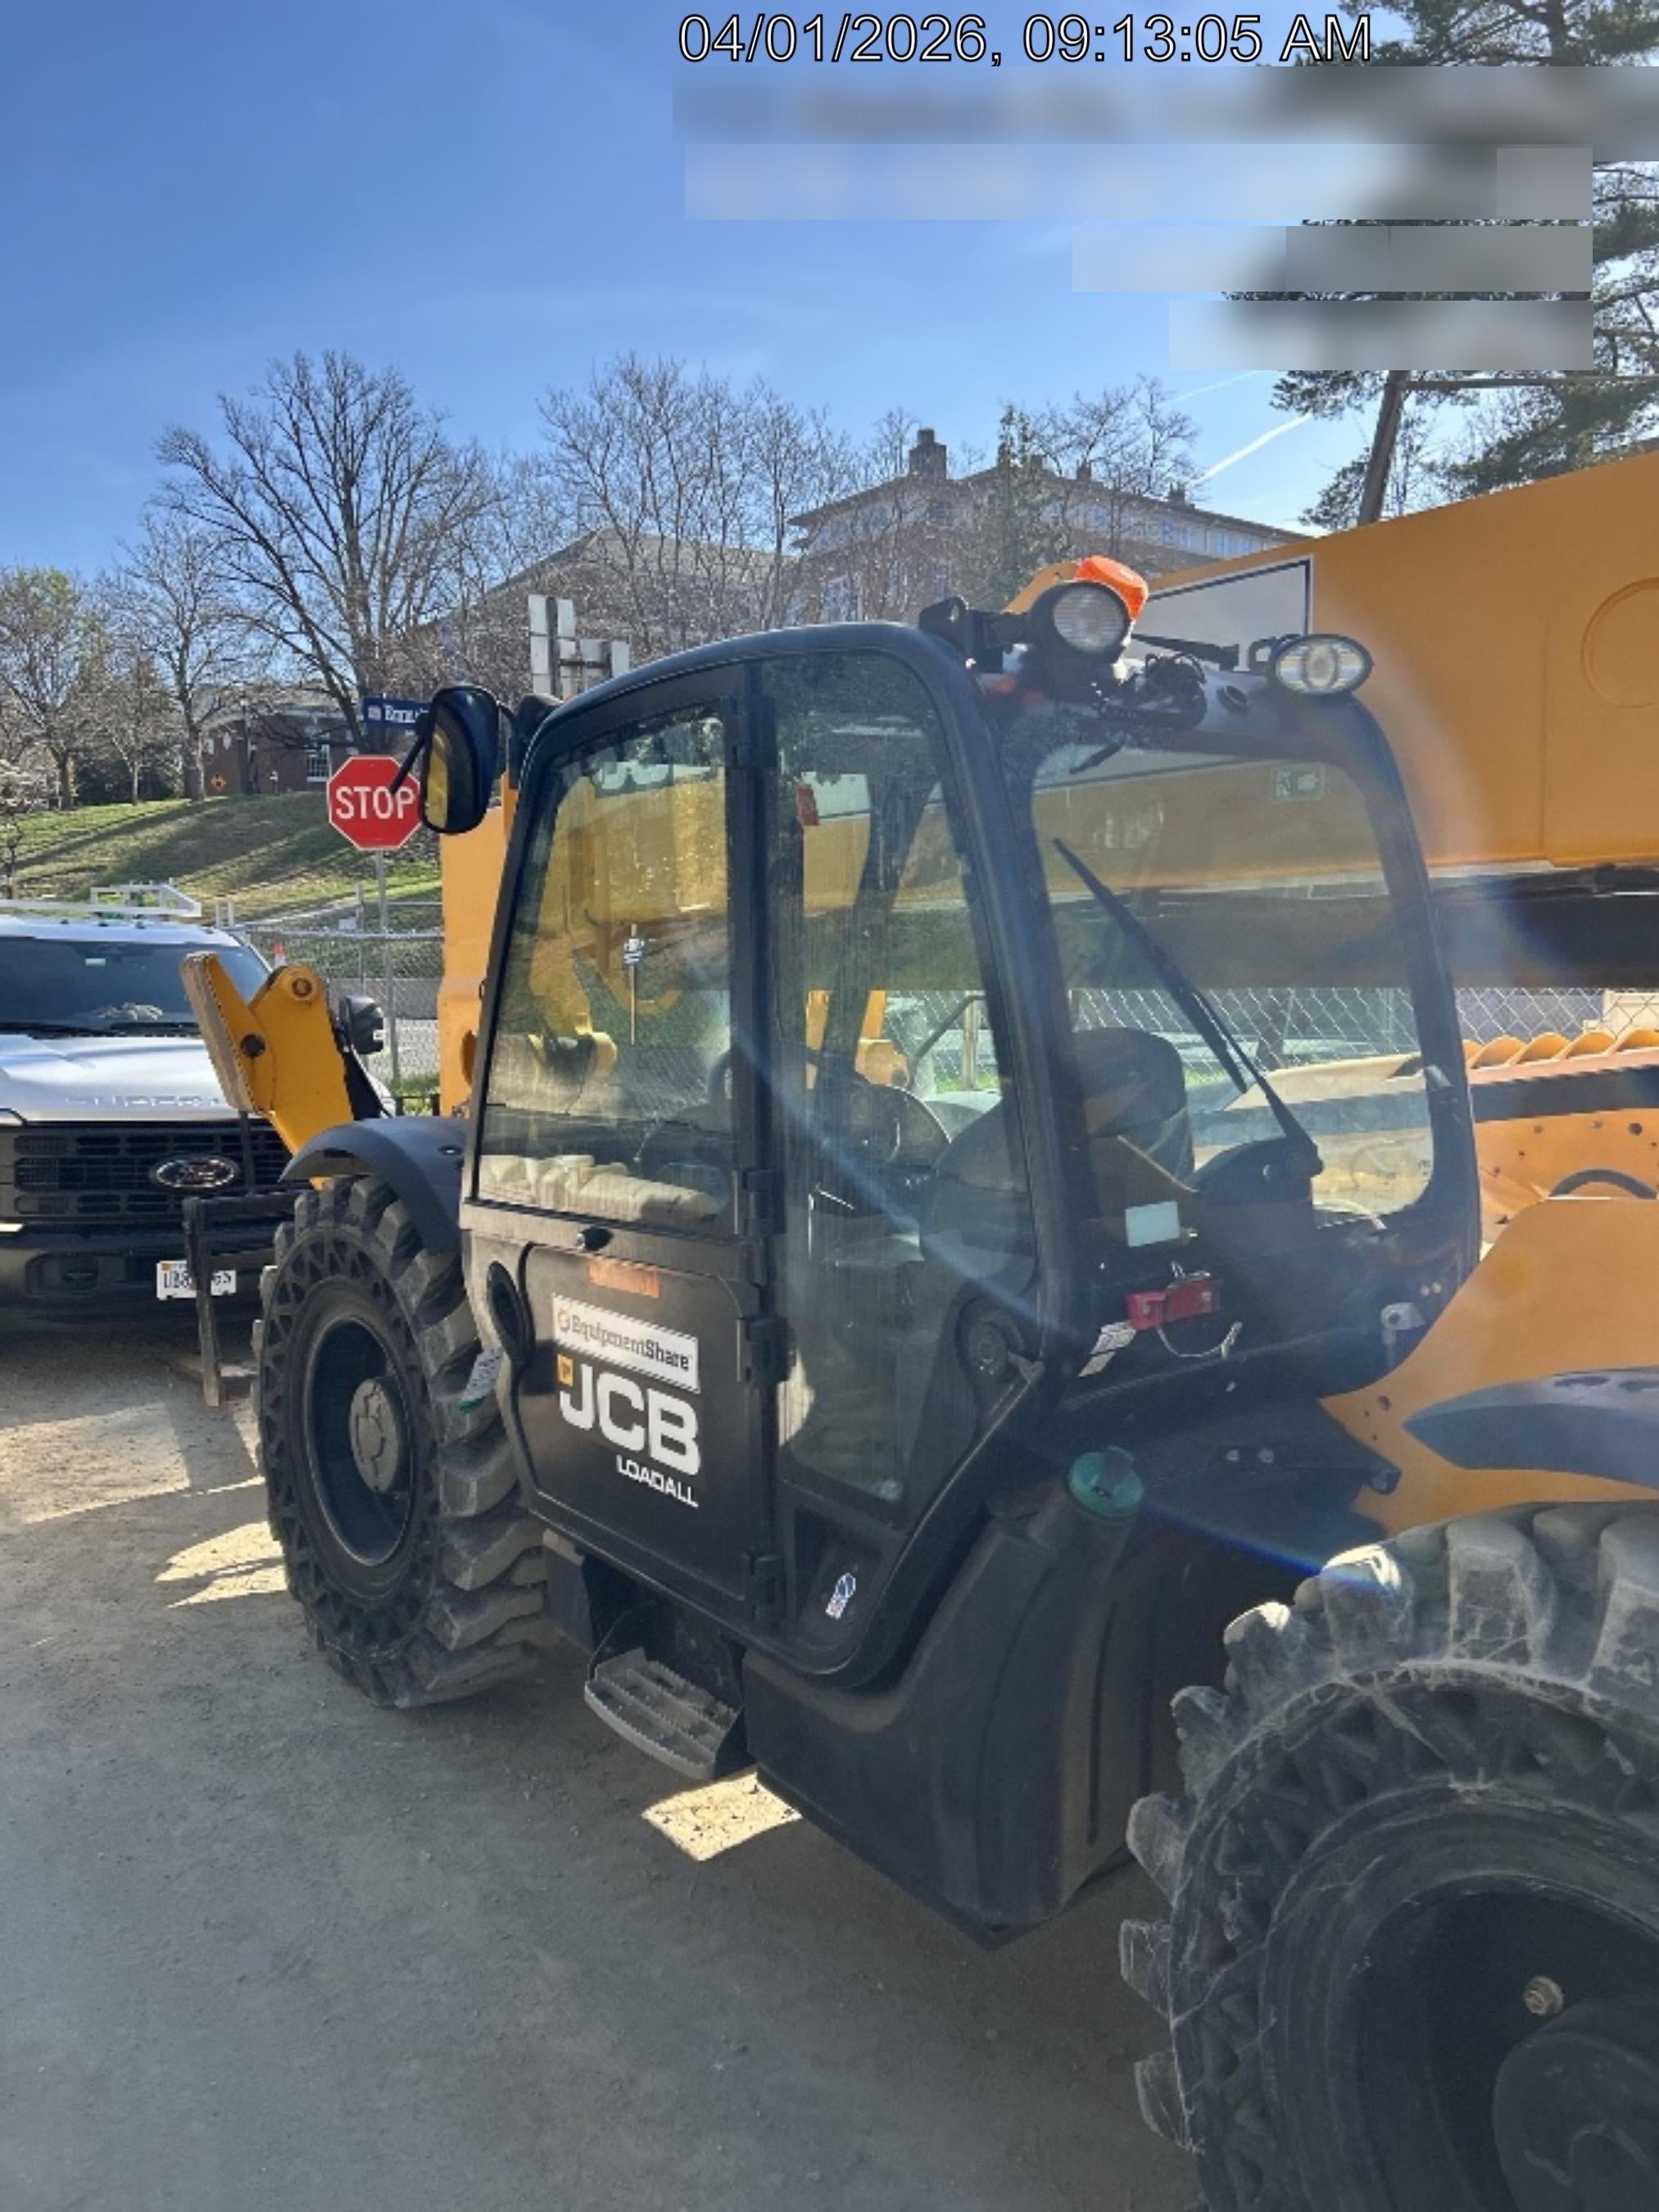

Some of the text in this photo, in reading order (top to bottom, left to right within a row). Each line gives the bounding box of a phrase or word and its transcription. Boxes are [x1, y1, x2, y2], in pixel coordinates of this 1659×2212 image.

[335, 786, 415, 819] STOP
[572, 1321, 689, 1371] EquipmentShare
[560, 1363, 700, 1475] JCB
[616, 1454, 699, 1508] LOADALL
